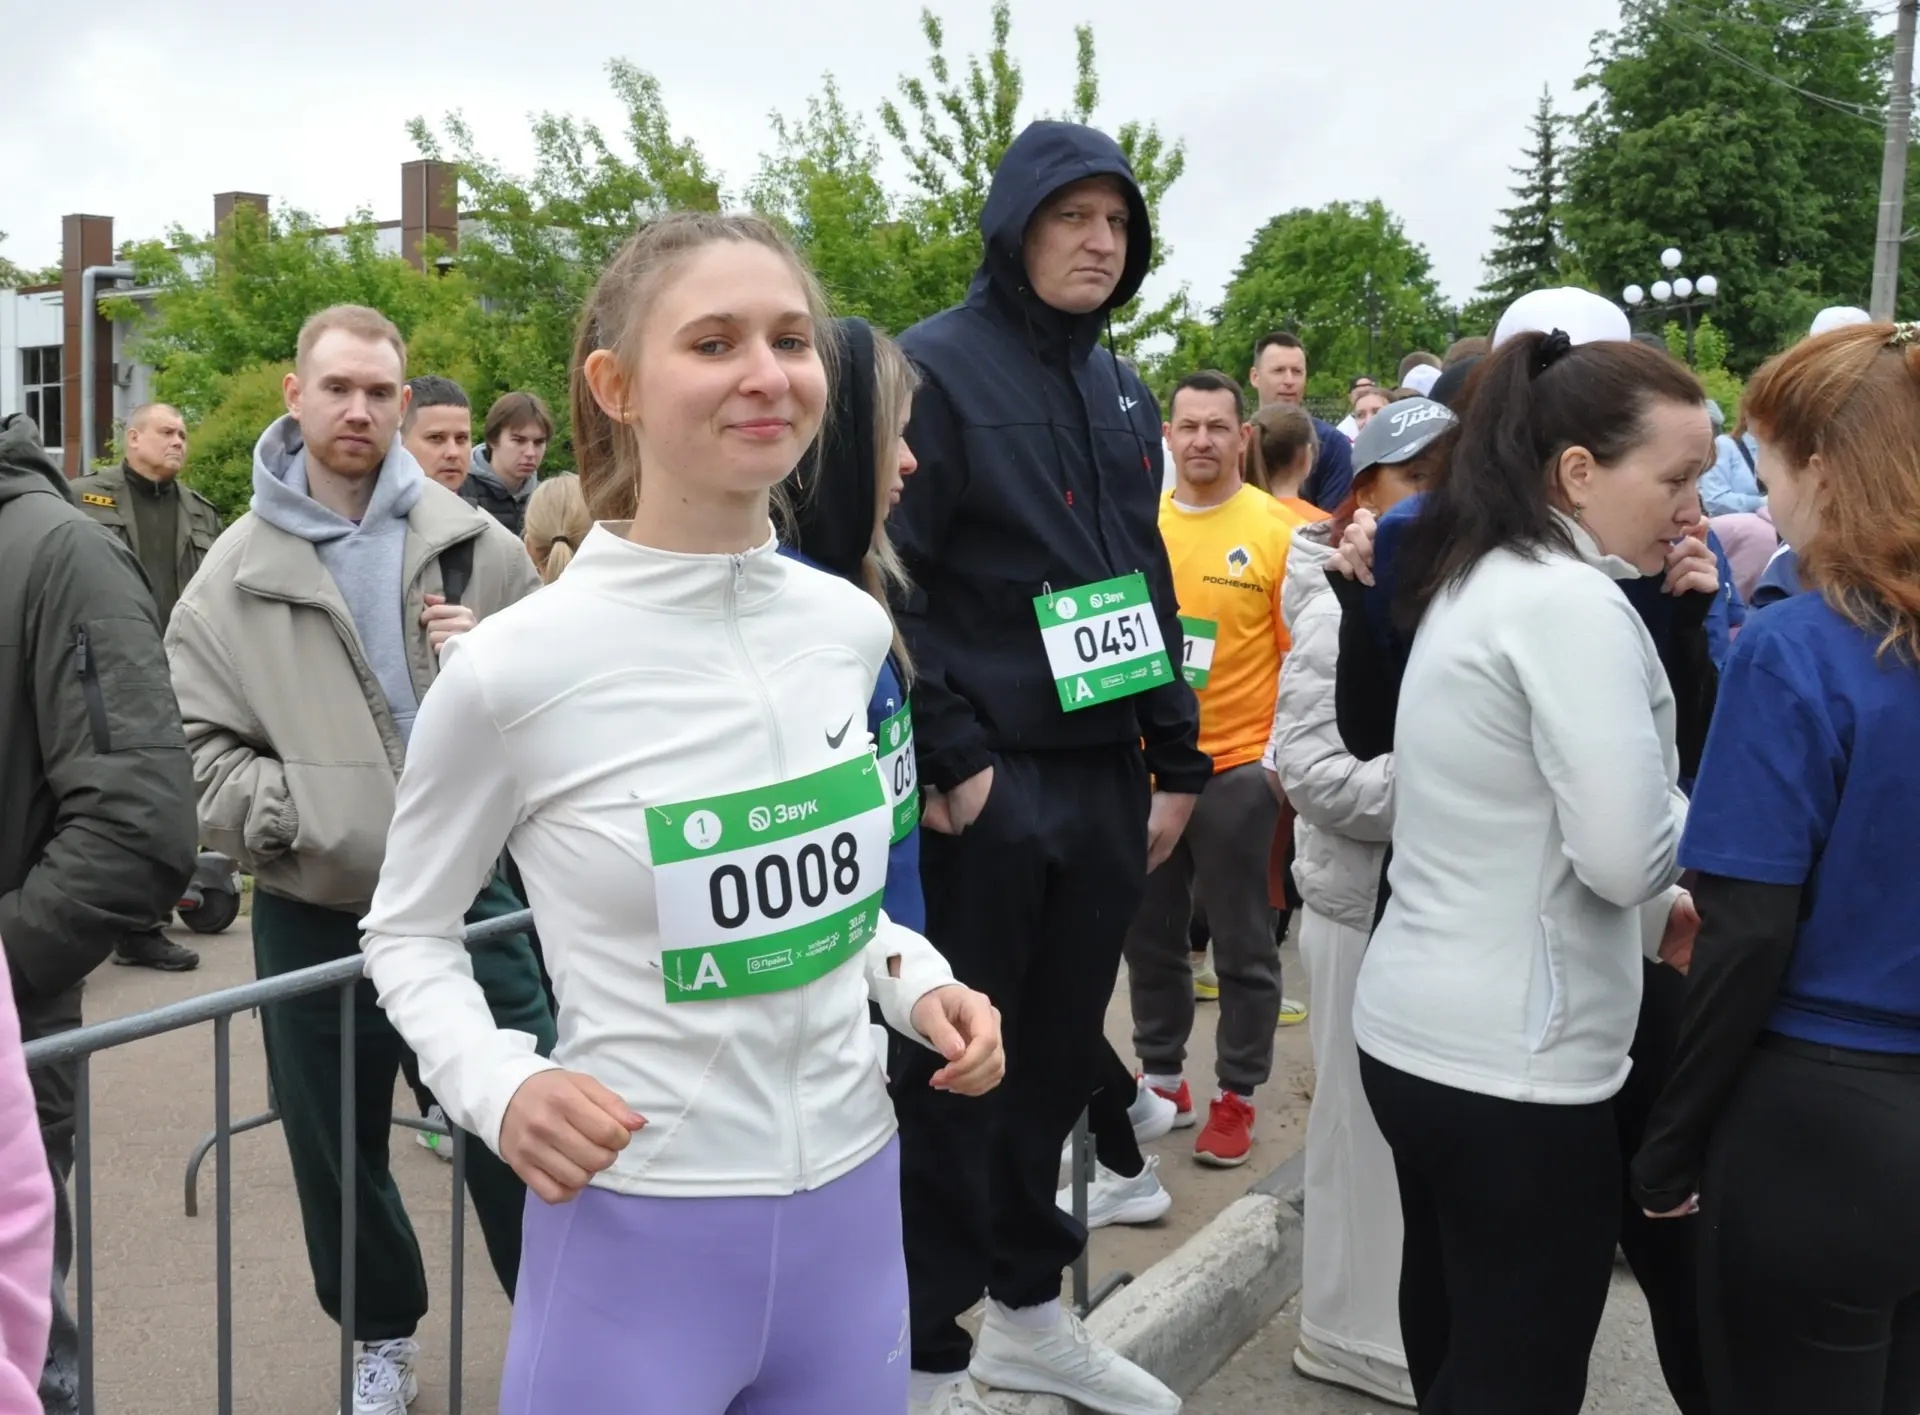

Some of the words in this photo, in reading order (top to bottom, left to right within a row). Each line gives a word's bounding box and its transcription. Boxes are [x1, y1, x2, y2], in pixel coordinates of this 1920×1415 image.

[1202, 575, 1264, 593] РОСНЕФТЬ
[1103, 590, 1126, 605] Звук
[1074, 612, 1149, 663] 0451
[774, 799, 819, 824] Звук
[697, 817, 706, 835] 1
[709, 832, 860, 929] 0008
